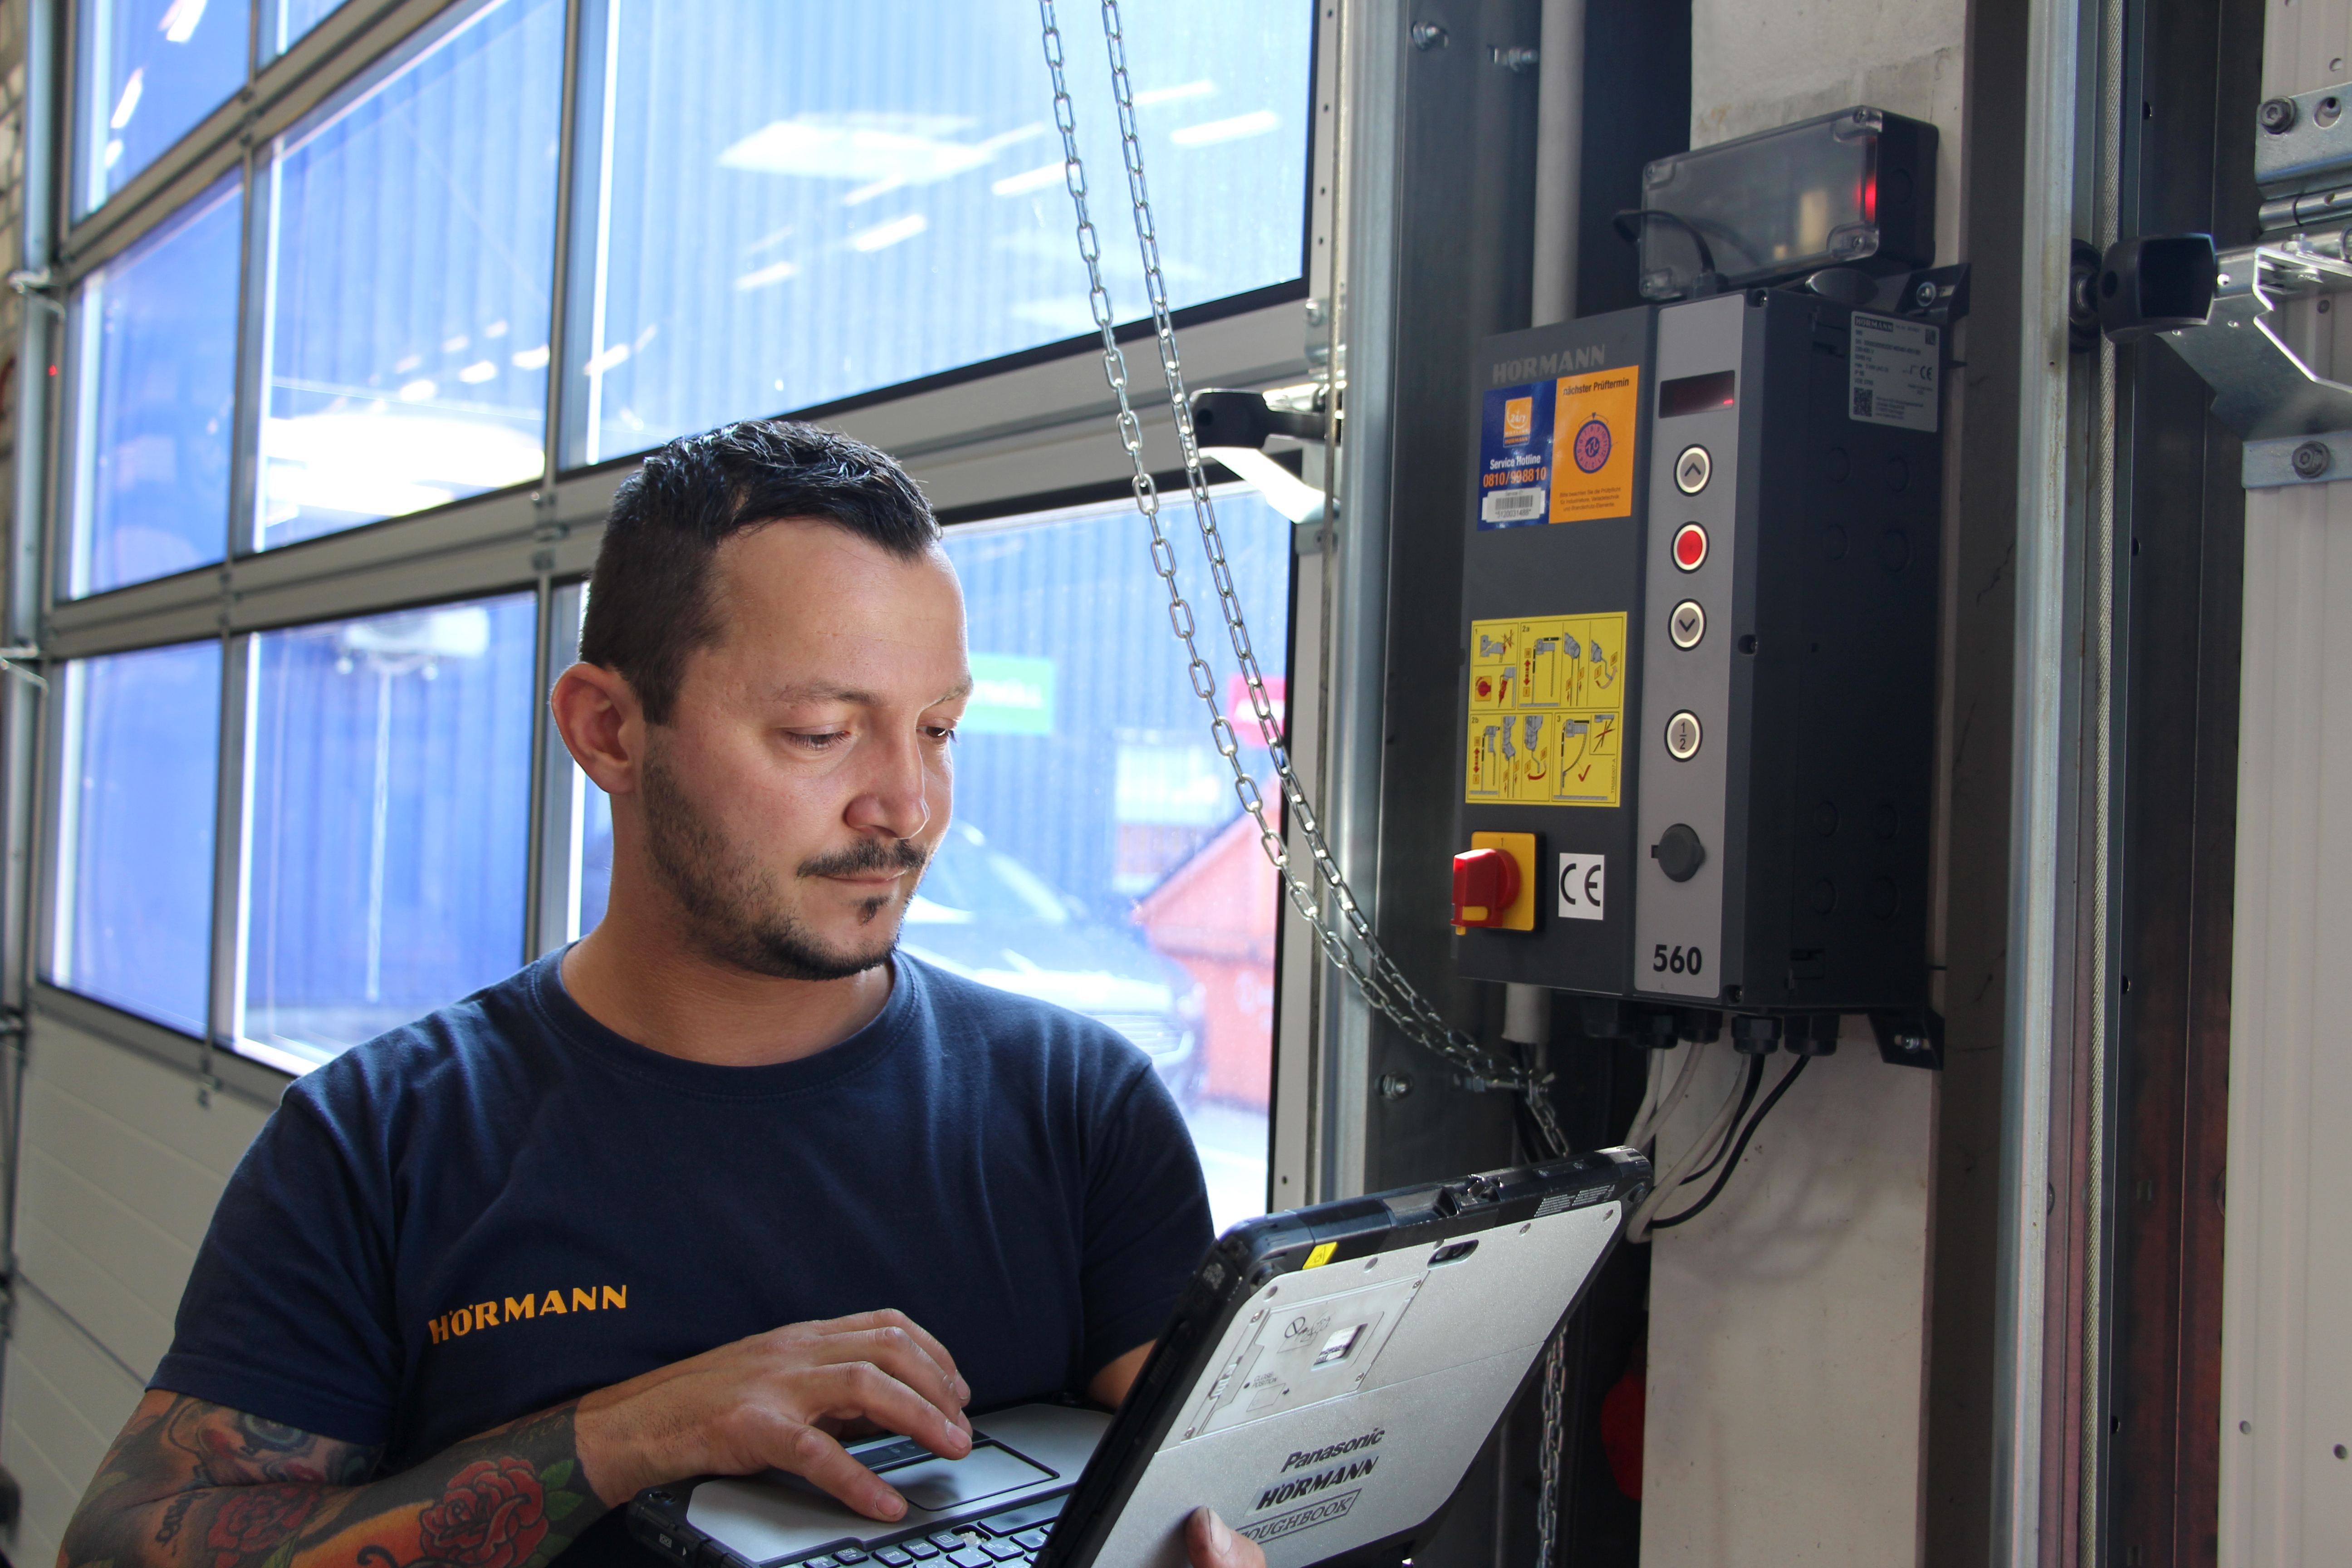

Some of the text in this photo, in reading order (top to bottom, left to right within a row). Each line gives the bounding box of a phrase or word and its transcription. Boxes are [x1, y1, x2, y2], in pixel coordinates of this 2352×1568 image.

[1563, 377, 1629, 396] nächster Prüftermin
[1483, 466, 1547, 488] 0810/998810
[1490, 454, 1541, 470] Service Hotline
[1560, 863, 1601, 906] CE
[1653, 944, 1702, 975] 560
[428, 1285, 627, 1344] HÖRMANN
[1280, 1427, 1385, 1473] Panasonic
[1256, 1455, 1379, 1510] HÖRMANN
